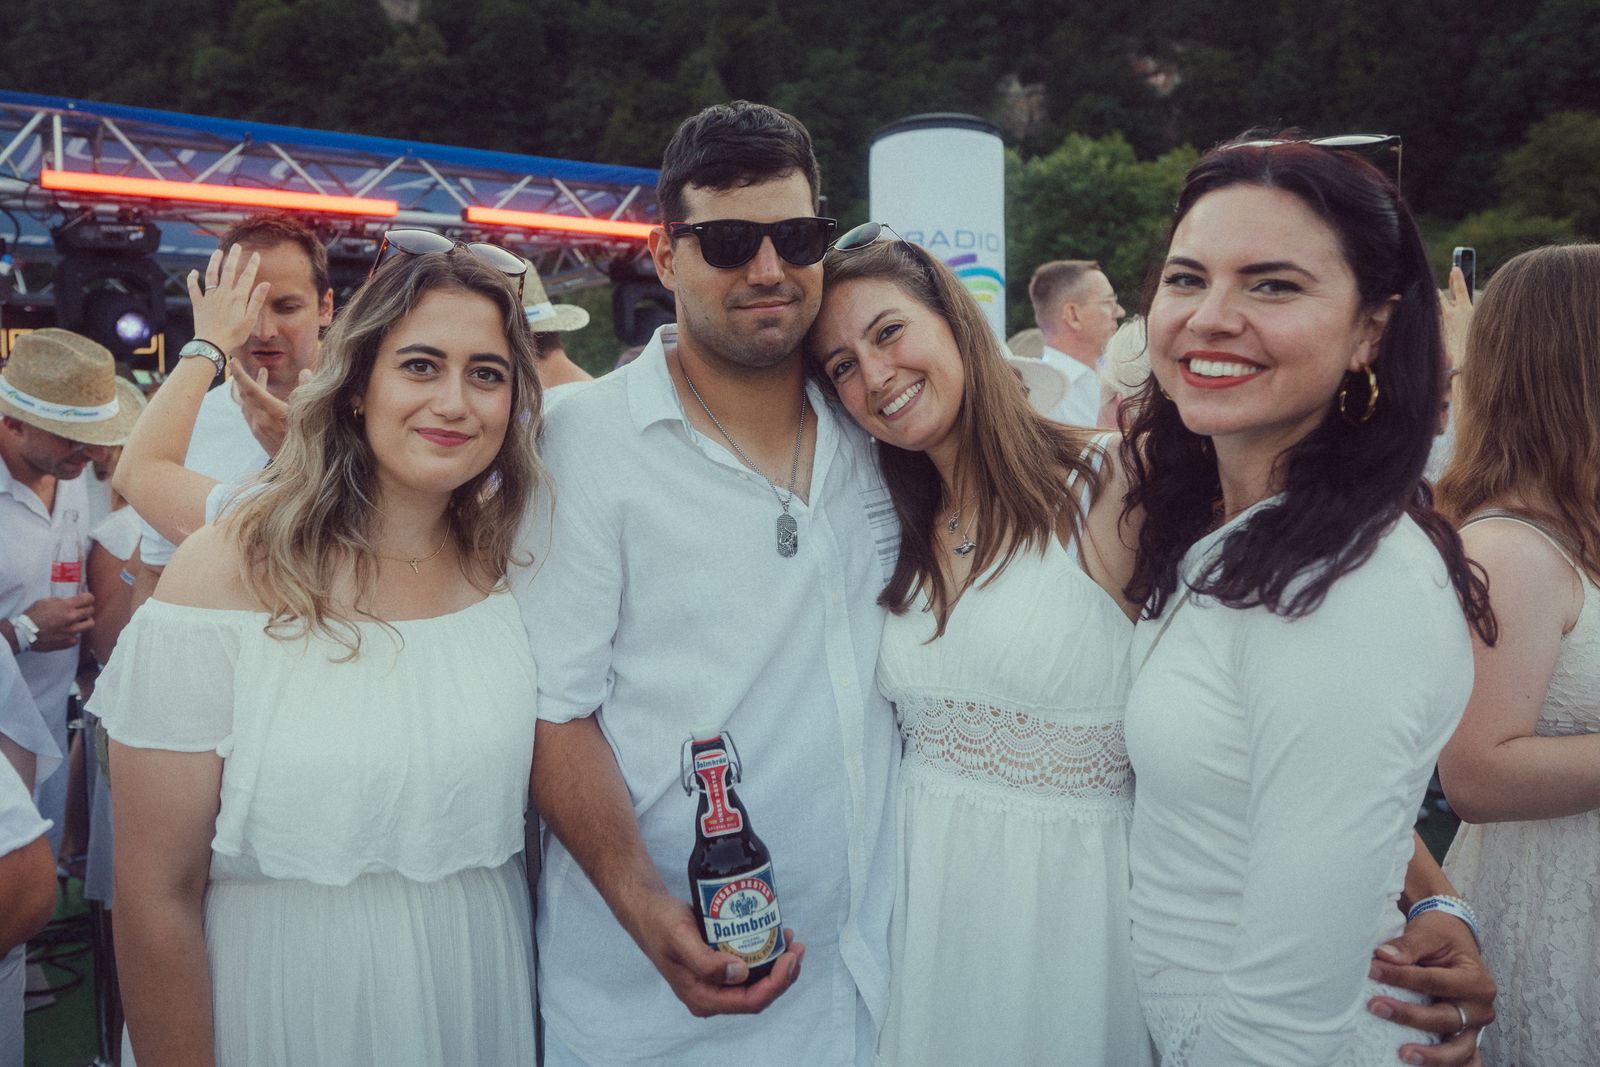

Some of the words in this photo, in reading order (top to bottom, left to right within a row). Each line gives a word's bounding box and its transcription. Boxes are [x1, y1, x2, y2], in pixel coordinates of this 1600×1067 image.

[904, 229, 1000, 252] RADIO
[712, 882, 738, 913] UNSER
[740, 880, 772, 898] BESTES
[713, 911, 776, 941] Palmbräu
